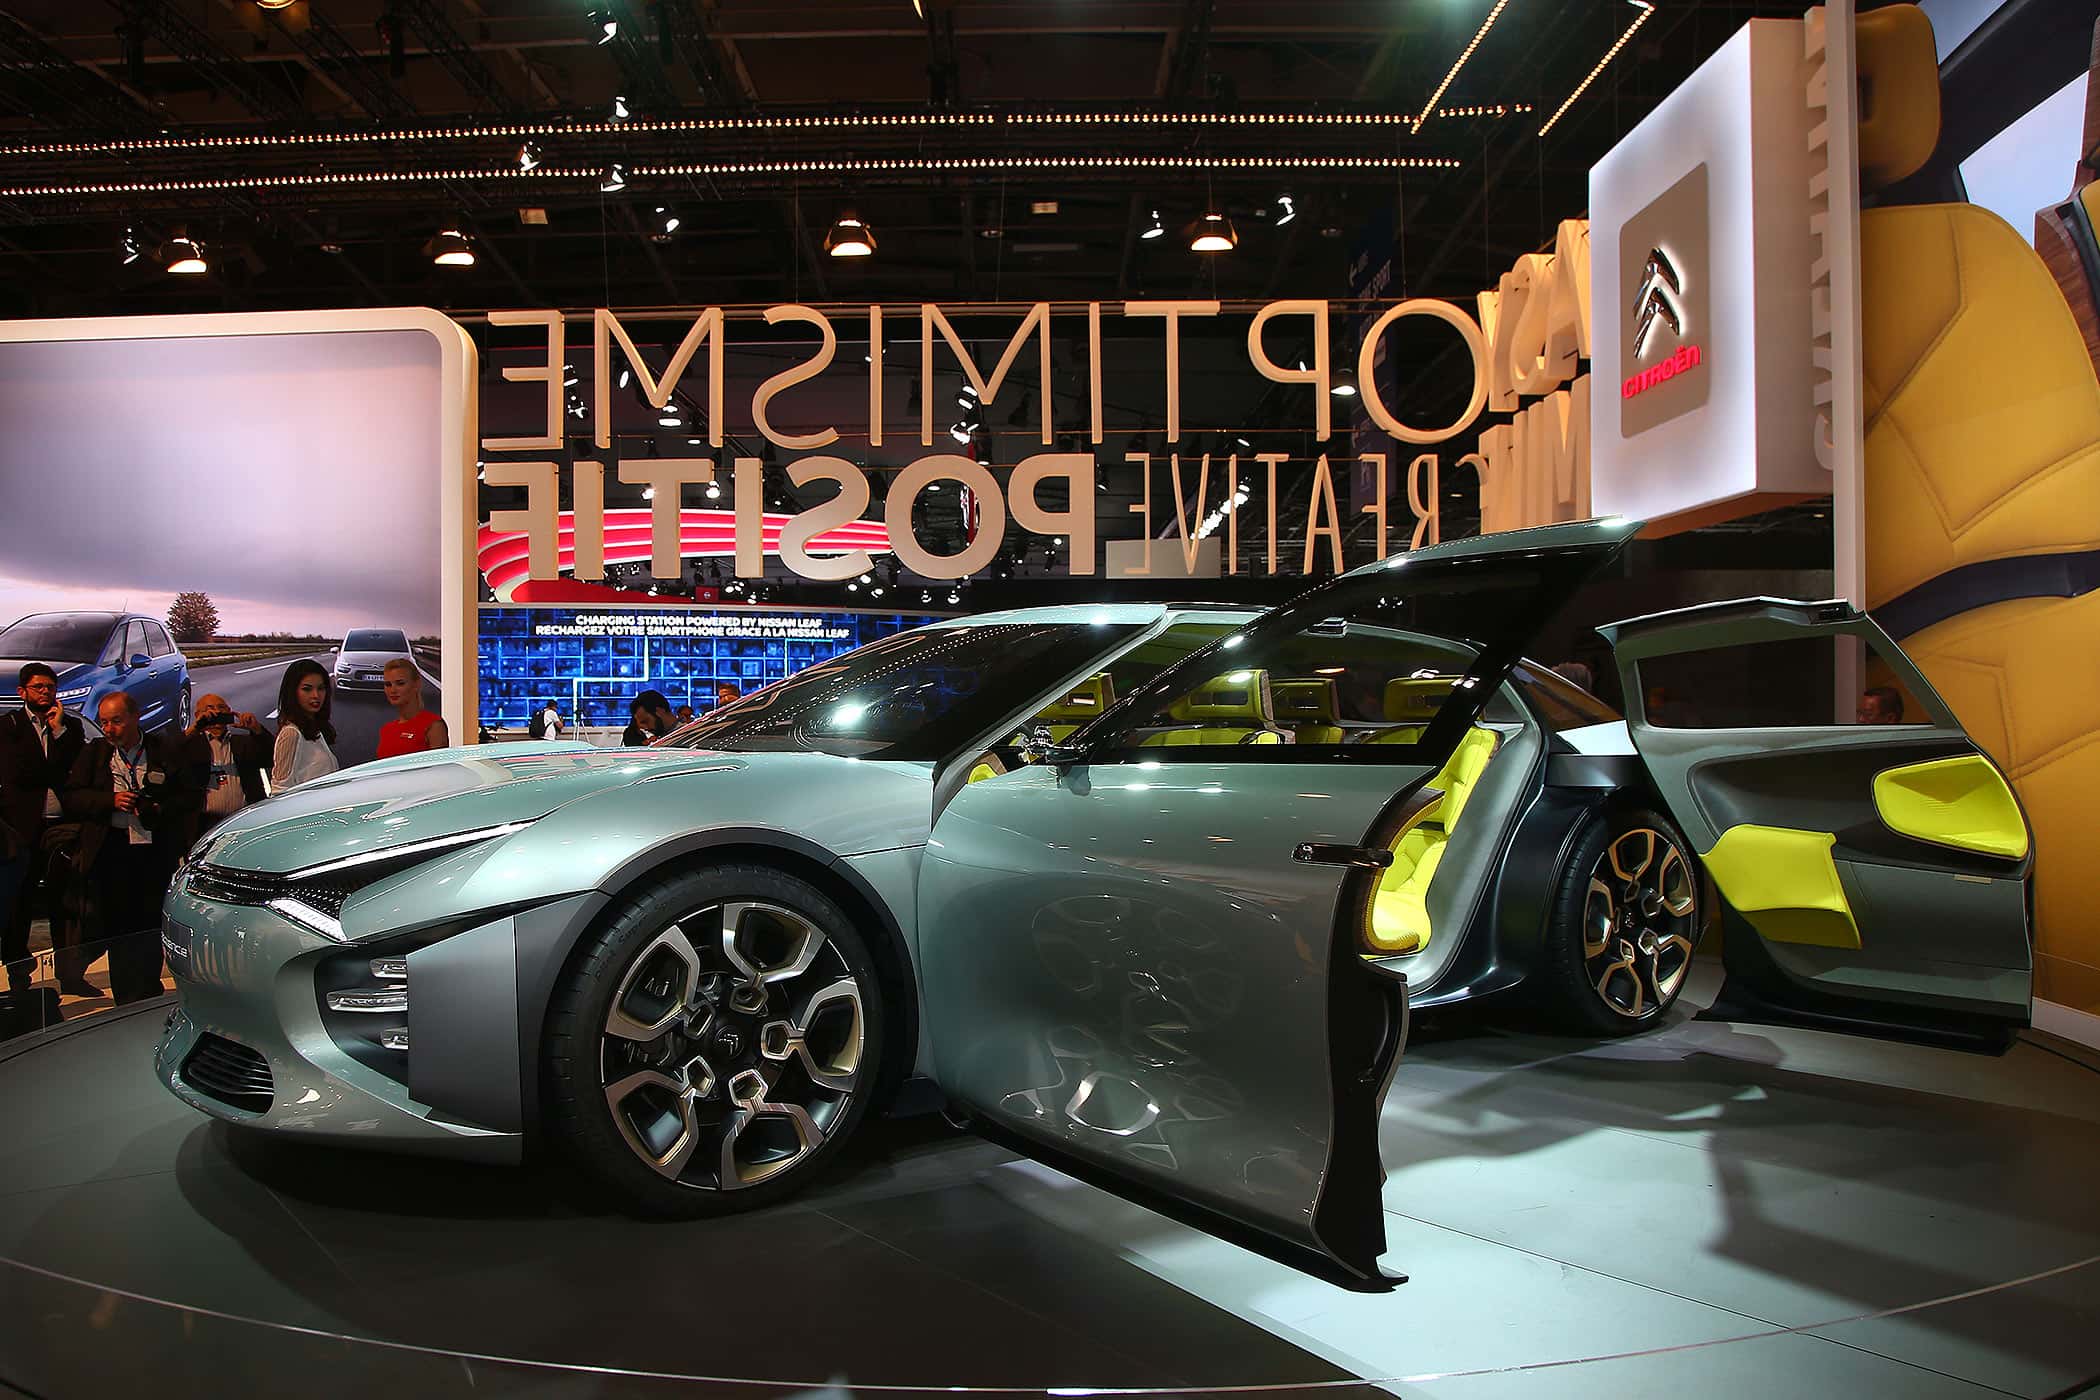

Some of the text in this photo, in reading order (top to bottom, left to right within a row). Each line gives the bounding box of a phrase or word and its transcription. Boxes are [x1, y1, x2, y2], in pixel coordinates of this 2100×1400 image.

[575, 614, 822, 628] CHARGING STATION POWERED BY NISSAN LEAF
[535, 625, 605, 636] RECHARGEZ
[607, 626, 645, 636] VOTRE
[646, 626, 724, 637] SMARTPHONE
[772, 628, 786, 638] LA
[787, 629, 824, 638] NISSAN
[825, 629, 849, 639] LEAF
